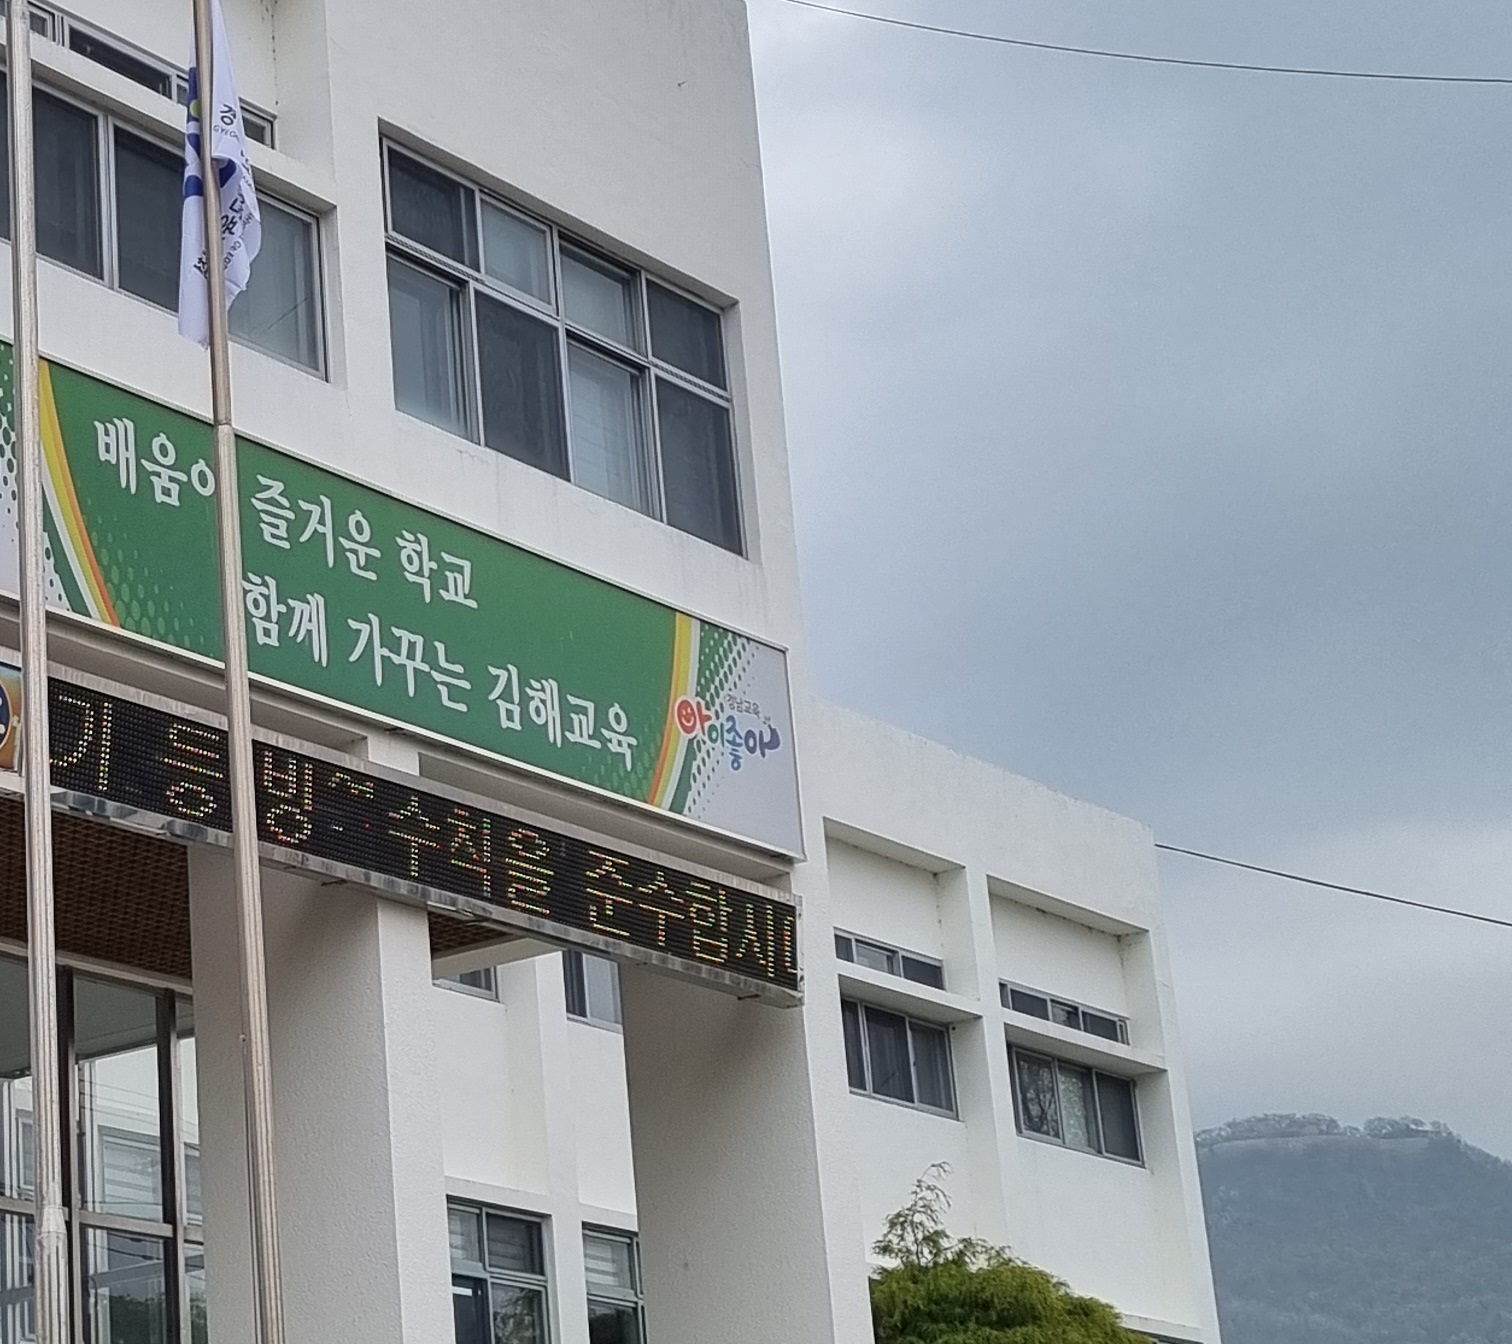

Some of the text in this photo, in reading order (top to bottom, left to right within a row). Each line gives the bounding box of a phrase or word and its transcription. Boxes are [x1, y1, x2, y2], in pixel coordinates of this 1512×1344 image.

[251, 474, 382, 582] 즐거운
[396, 529, 478, 609] 학교
[241, 571, 639, 772] 함께 가꾸는 김해교육
